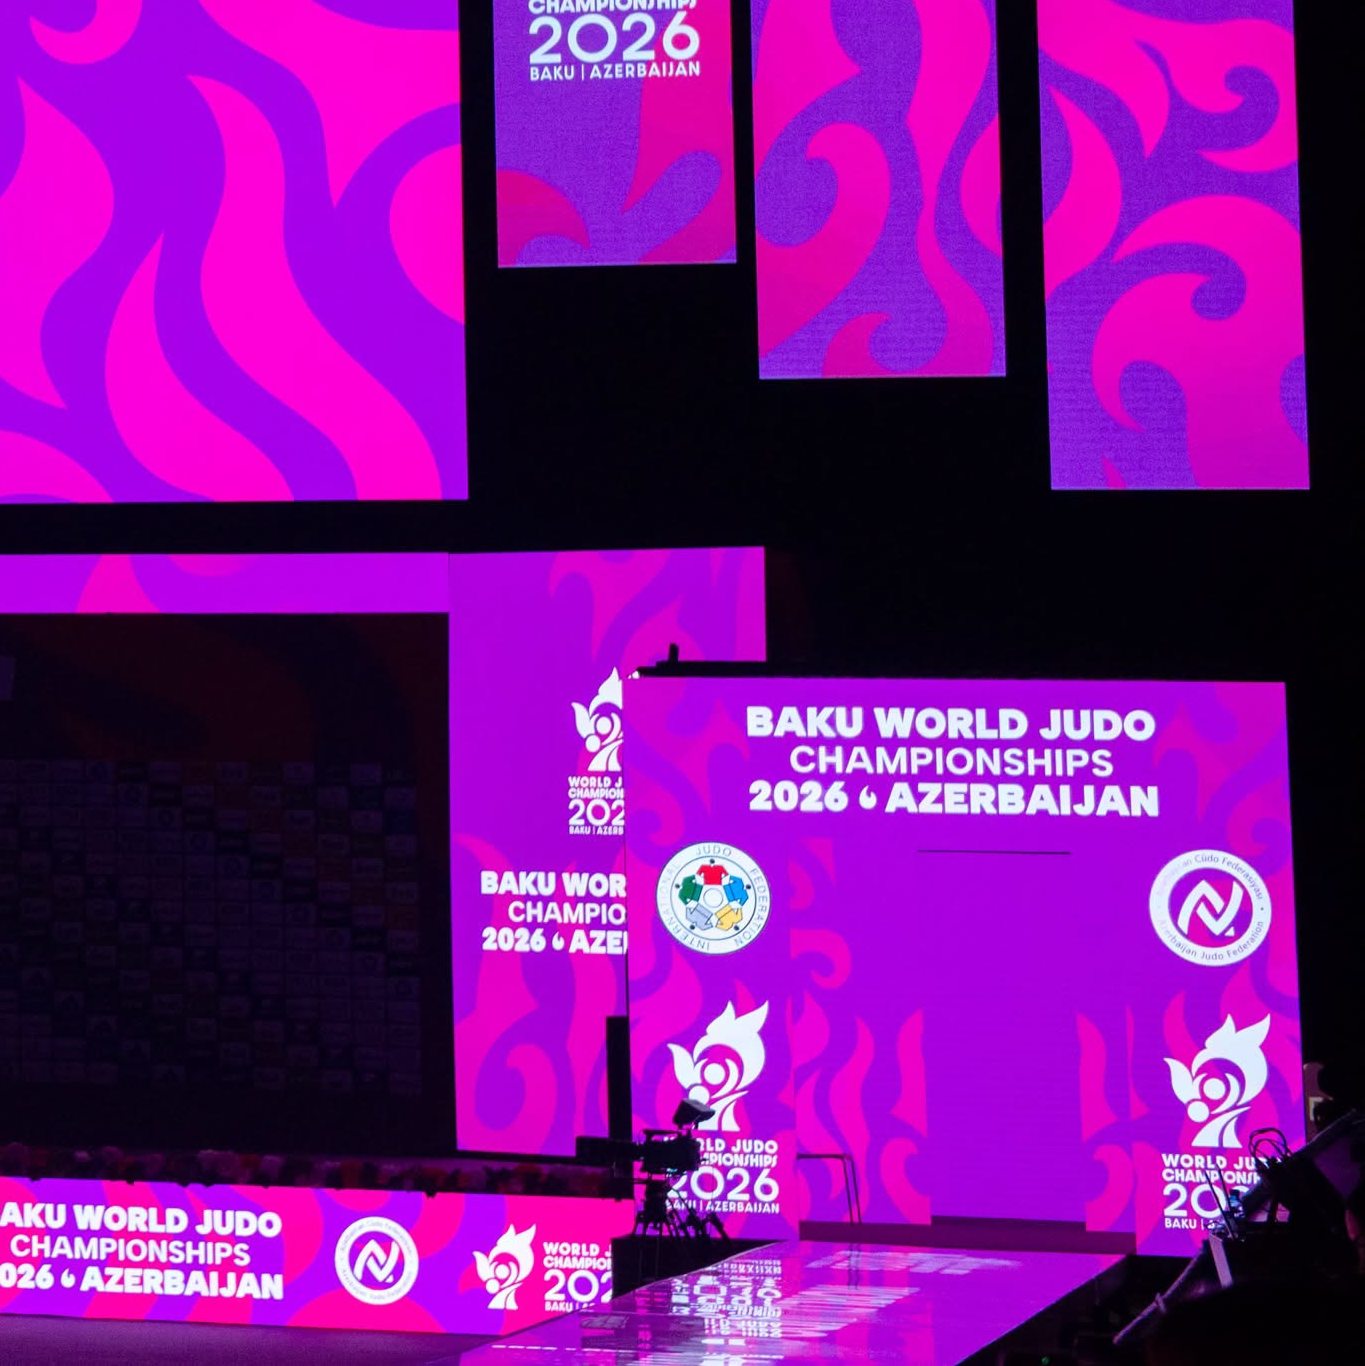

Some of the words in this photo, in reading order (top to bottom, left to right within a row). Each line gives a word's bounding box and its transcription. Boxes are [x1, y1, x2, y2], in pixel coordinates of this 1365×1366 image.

[528, 10, 700, 65] 2026
[530, 65, 575, 81] BAKU
[590, 61, 701, 79] AZERBAIJAN
[746, 705, 864, 738] BAKU
[873, 707, 1029, 739] WORLD
[1039, 708, 1156, 741] JUDO
[789, 744, 1114, 777] CHAMPIONSHIPS
[567, 775, 612, 788] WORLD
[748, 780, 848, 812] 2026
[885, 781, 1160, 817] AZERBAIJAN
[568, 798, 625, 827] 202
[695, 844, 732, 857] JUDO
[480, 870, 556, 896] BAKU
[561, 872, 627, 898] WOR
[508, 900, 627, 926] CHAMPIO
[481, 927, 547, 952] 2026
[1201, 951, 1224, 961] Judo
[731, 1139, 778, 1154] JUDO
[1161, 1153, 1227, 1169] WORLD
[666, 1165, 780, 1202] 2026
[706, 1200, 780, 1214] AZERBAIJAN
[73, 1204, 189, 1234] WORLD
[195, 1209, 283, 1238] JUDO
[1164, 1218, 1197, 1230] BAKU
[10, 1234, 251, 1267] CHAMPIONSHIPS
[542, 1241, 600, 1257] WORLD
[80, 1266, 284, 1300] AZERBAIJAN
[544, 1300, 573, 1313] BAKU
